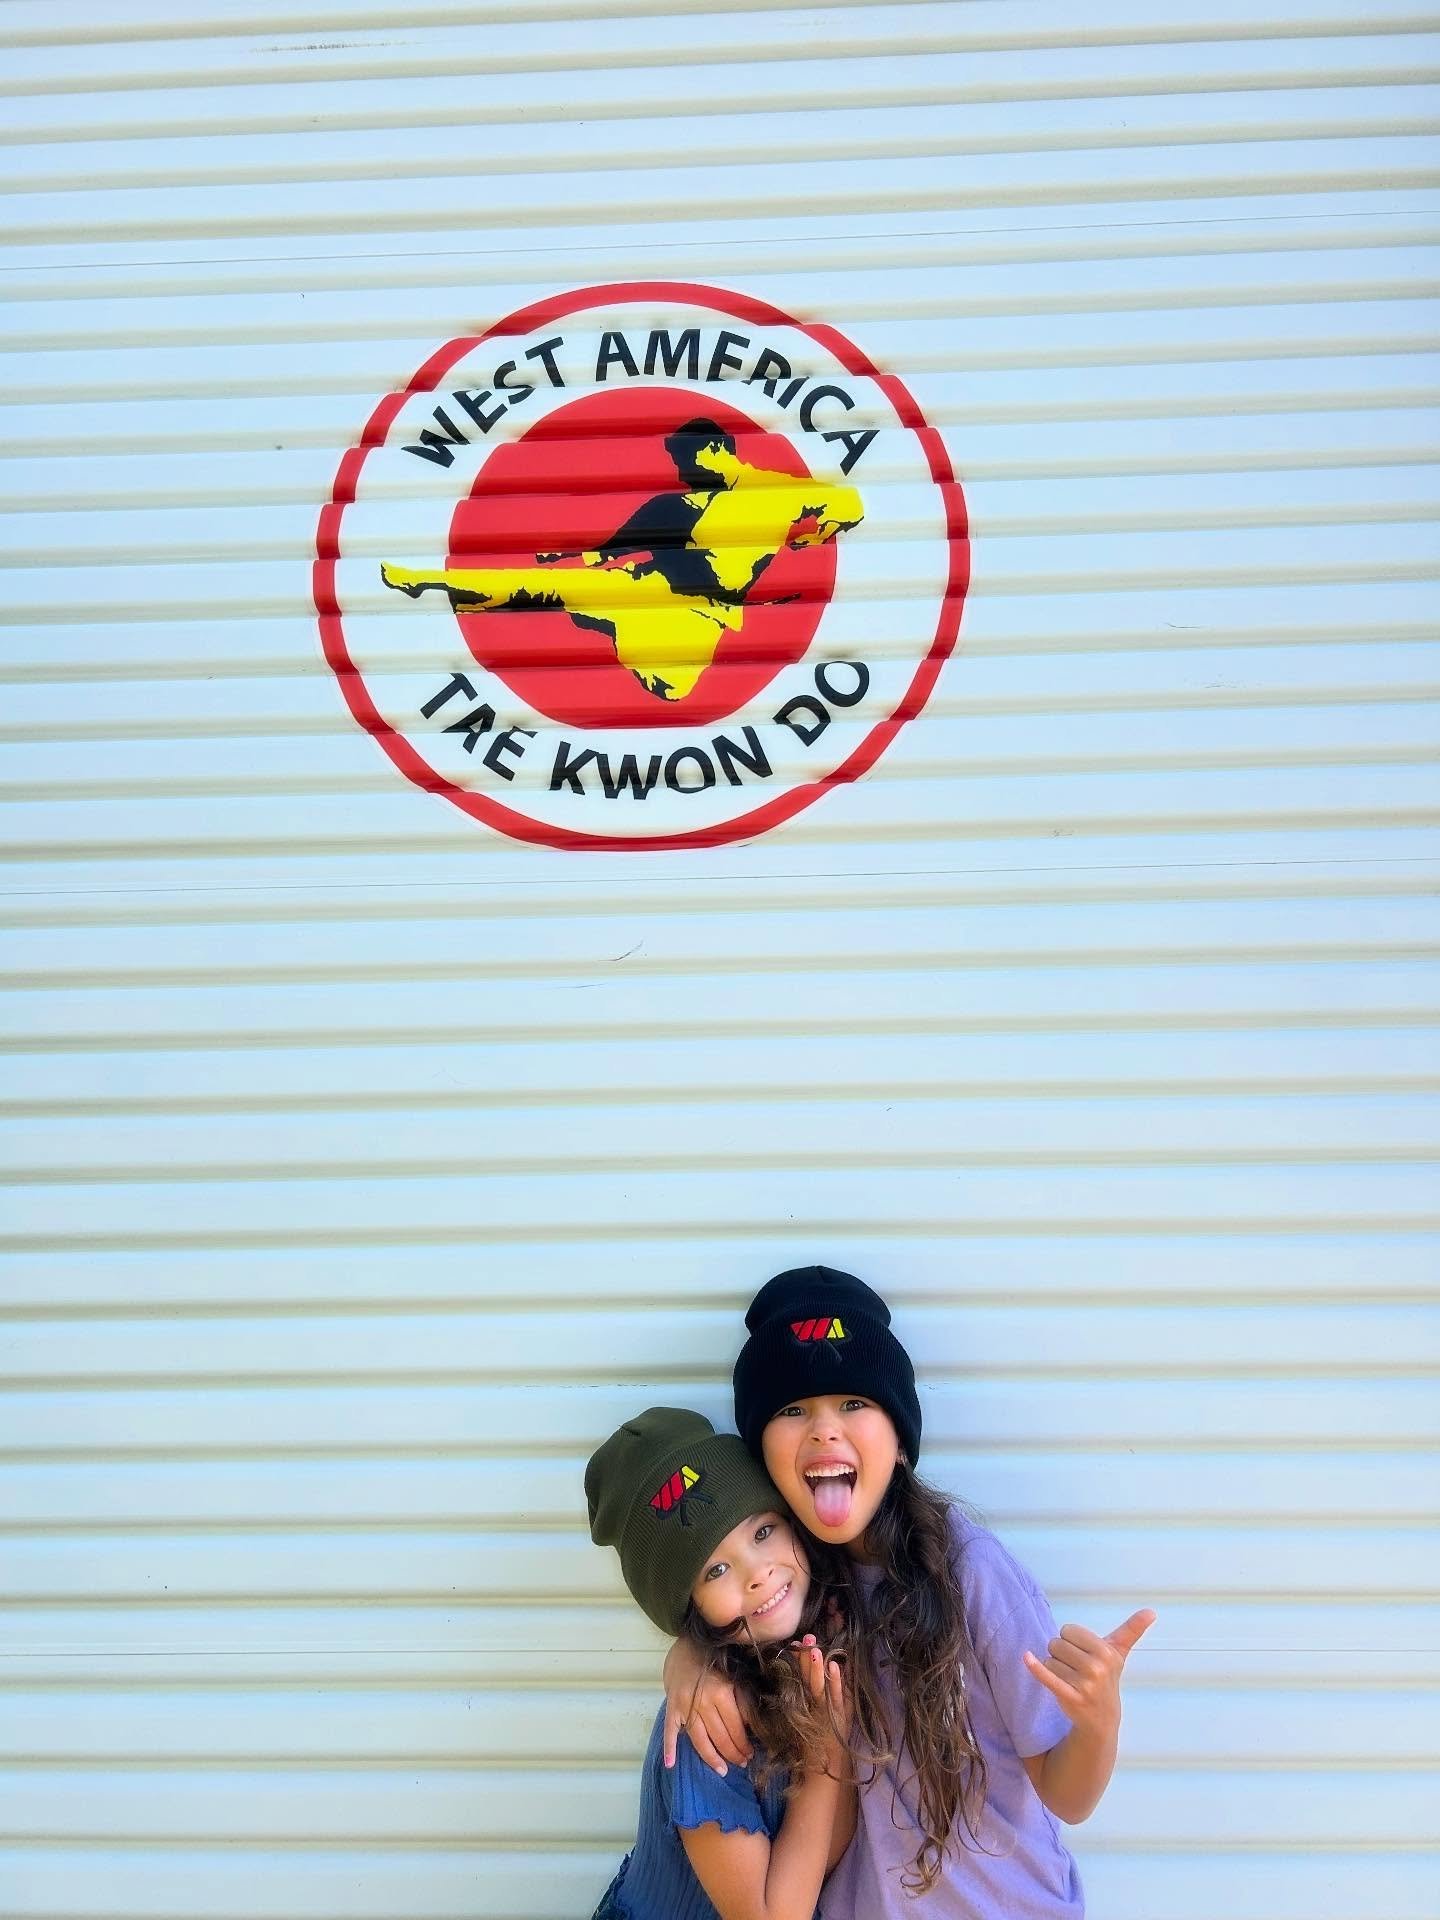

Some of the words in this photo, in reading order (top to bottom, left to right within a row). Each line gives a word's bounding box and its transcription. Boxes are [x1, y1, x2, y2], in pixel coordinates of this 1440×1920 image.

[401, 336, 566, 468] WEST
[595, 328, 881, 476] AMERICA
[420, 672, 538, 782] TAE
[549, 725, 774, 800] KWON
[772, 661, 870, 747] DO
